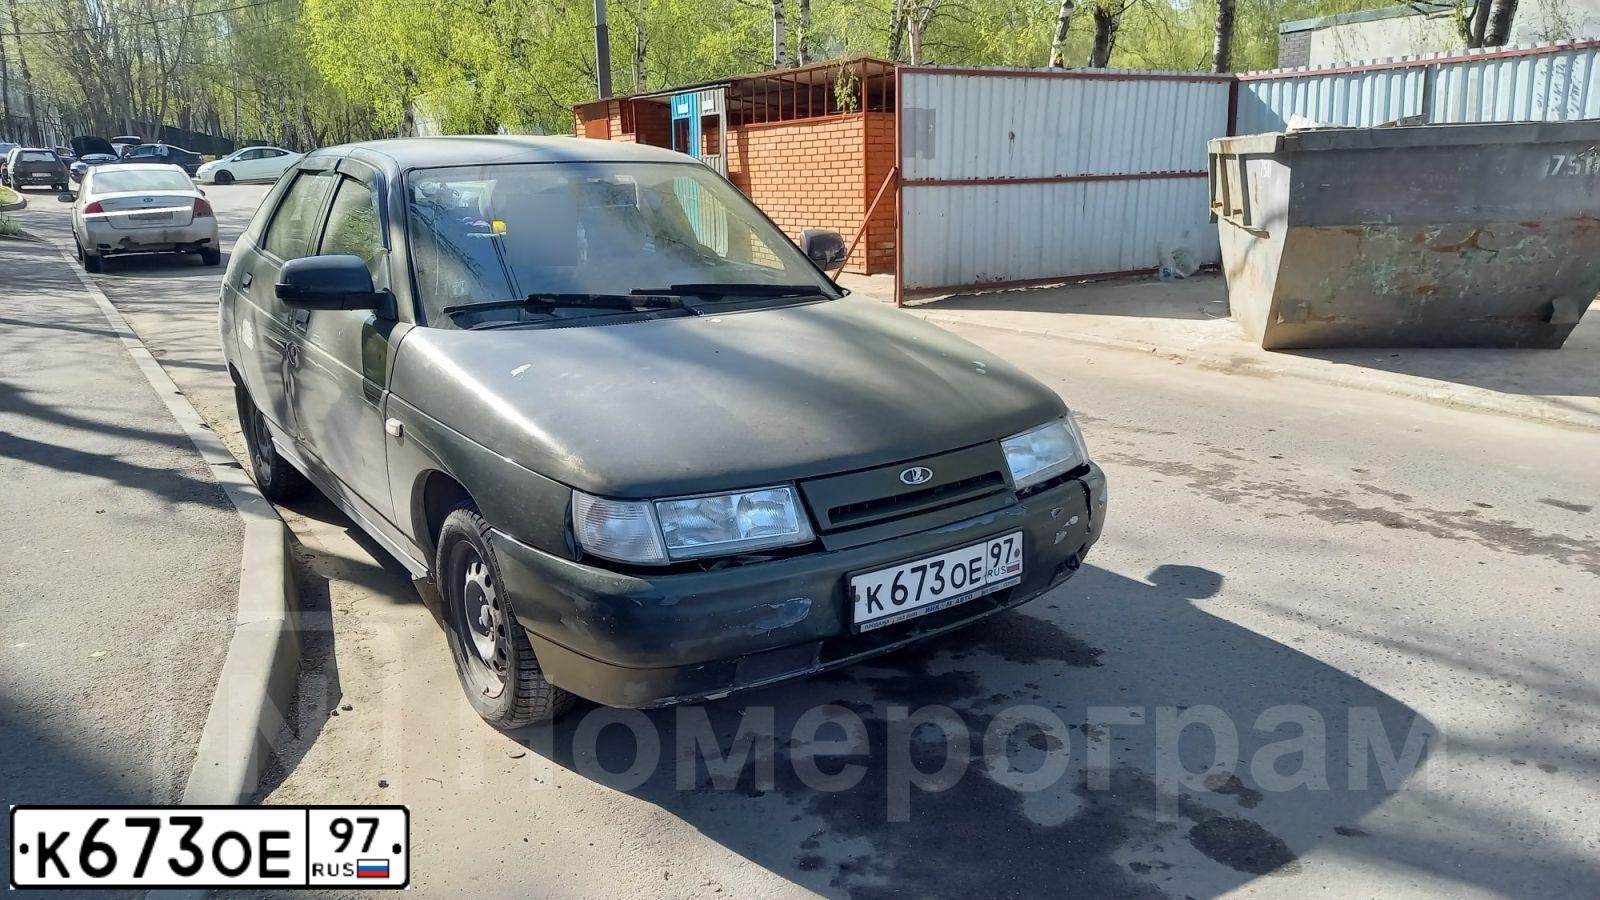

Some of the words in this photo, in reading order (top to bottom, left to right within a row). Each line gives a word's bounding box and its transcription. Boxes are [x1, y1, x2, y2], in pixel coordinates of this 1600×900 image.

[990, 537, 1014, 568] 97
[866, 556, 982, 614] К673ОЕ
[987, 565, 1007, 578] RUS
